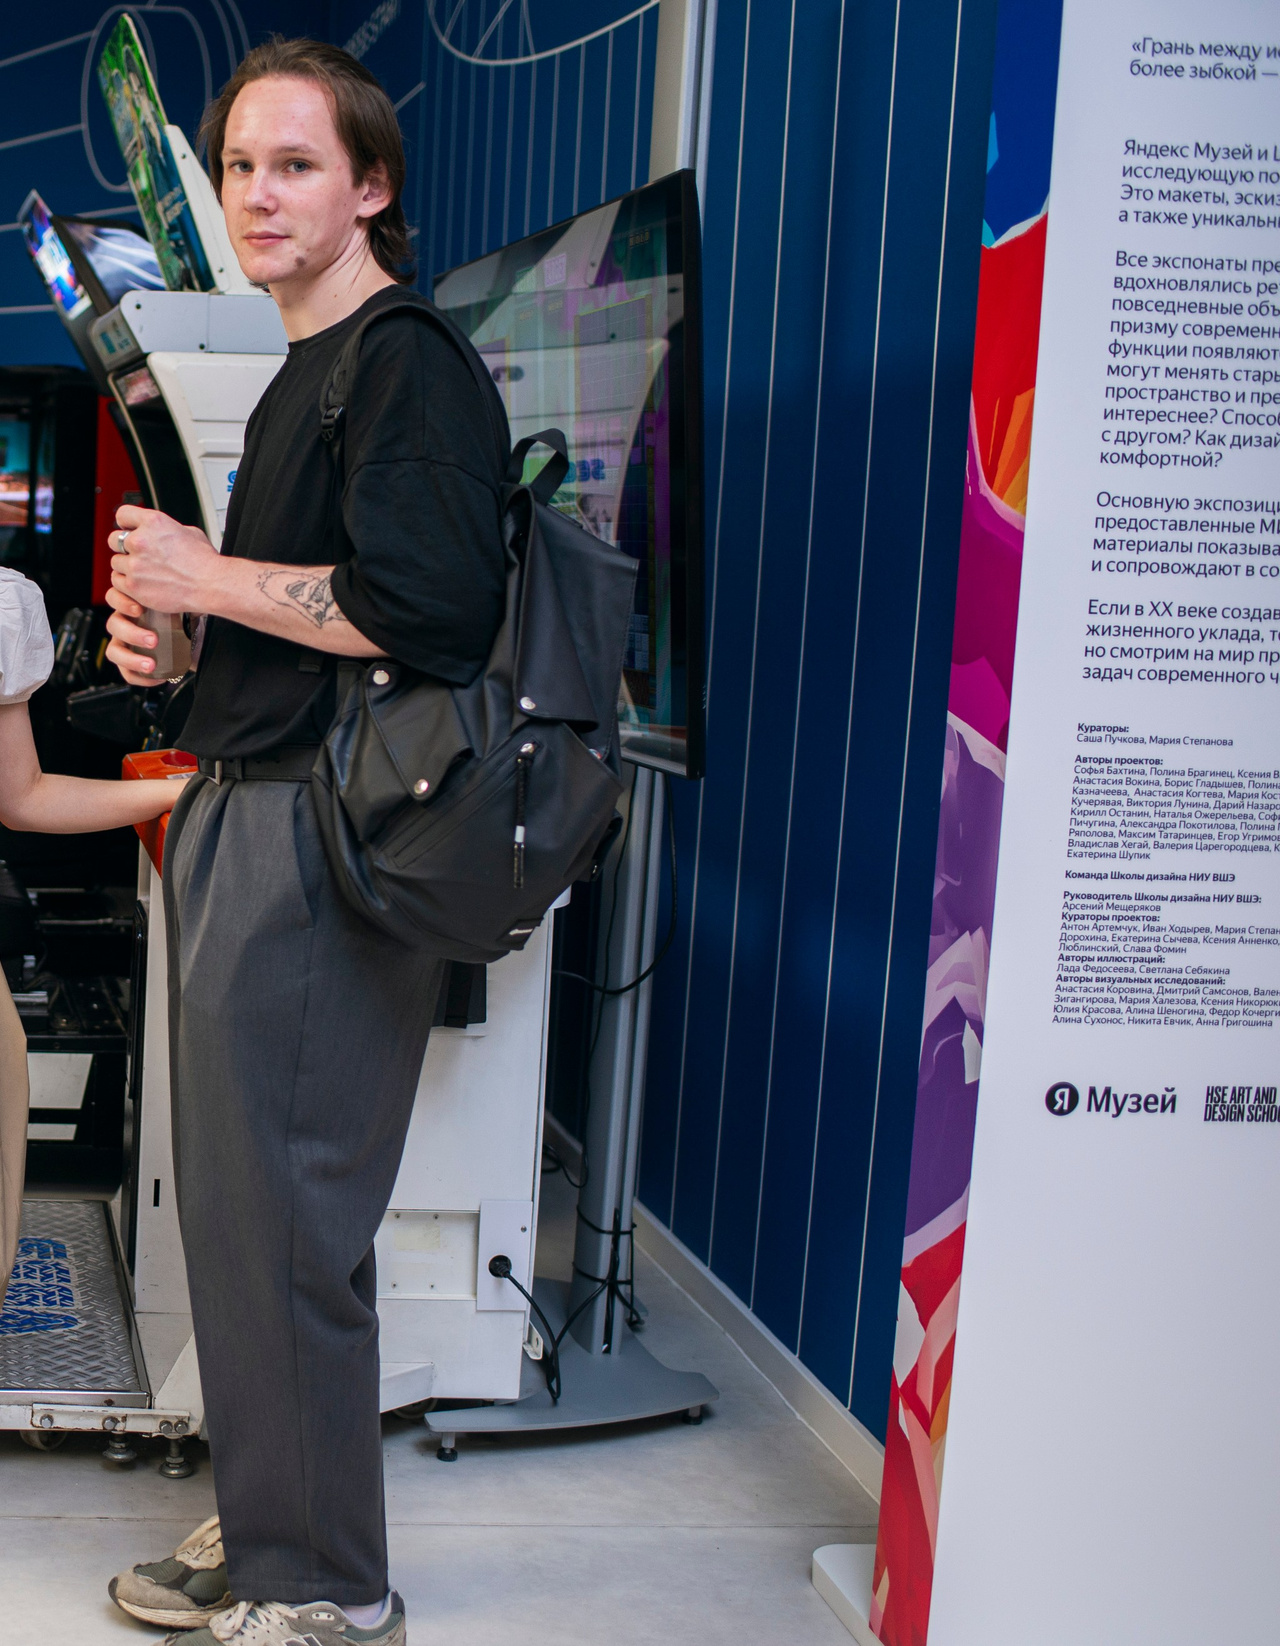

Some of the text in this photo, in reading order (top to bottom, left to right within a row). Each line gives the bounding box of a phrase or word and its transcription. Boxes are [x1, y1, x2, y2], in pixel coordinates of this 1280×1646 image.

[1131, 36, 1195, 58] «Грань
[1198, 43, 1263, 62] между
[1129, 59, 1257, 80] более зыбкой
[1123, 139, 1189, 159] Яндекс
[1193, 142, 1254, 163] Музей
[1256, 148, 1268, 161] и
[1121, 165, 1254, 186] исследующую
[1120, 183, 1229, 206] Это макеты,
[1118, 209, 1188, 224] а также
[1115, 250, 1247, 271] Все экспонаты
[1113, 276, 1252, 293] вдохновлялись
[1111, 298, 1243, 315] повседневные
[1110, 320, 1178, 338] призму
[1108, 338, 1188, 359] функции
[1106, 364, 1228, 382] могут менять
[1104, 385, 1245, 404] пространство и
[1103, 407, 1218, 425] интереснее?
[1101, 428, 1227, 447] с другом? Как
[1099, 448, 1222, 469] комфортной?
[1096, 490, 1189, 513] Основную
[1094, 516, 1255, 533] предоставленные
[1092, 537, 1193, 555] материалы
[1091, 559, 1255, 577] и сопровождают в
[1087, 598, 1130, 615] Если
[1134, 603, 1144, 616] в
[1177, 605, 1217, 618] веке
[1085, 623, 1264, 643] жизненного уклада,
[1084, 645, 1254, 666] но смотрим на мир
[1082, 666, 1265, 685] задач современного
[1077, 722, 1129, 735] Кураторы:
[1076, 733, 1103, 742] Саша
[1148, 734, 1181, 747] Мария
[1182, 735, 1233, 746] Степанова
[1074, 754, 1163, 766] Авторы проектов:
[1073, 764, 1105, 776] Софья
[1149, 766, 1186, 776] Полина
[1237, 768, 1271, 778] Ксения
[1072, 775, 1124, 785] Анастасия
[1164, 777, 1194, 789] Борис
[1133, 787, 1184, 797] Анастасия
[1227, 789, 1259, 801] Мария
[1125, 797, 1172, 809] Виктория
[1212, 799, 1245, 811] Дарий
[1070, 806, 1107, 818] Кирилл
[1153, 808, 1192, 818] Наталья
[1119, 818, 1177, 831] Александра
[1239, 821, 1276, 830] Полина
[1117, 828, 1156, 838] Максим
[1217, 831, 1240, 843] Егор
[1067, 838, 1119, 849] Владислав
[1152, 840, 1193, 852] Валерия
[1066, 848, 1150, 861] Екатерина Шупик
[1064, 869, 1235, 882] Команда Школы дизайна НИУ ВШЭ
[1063, 890, 1261, 903] Руководитель Школы дизайна НИУ ВШЭ:
[1061, 900, 1161, 913] Арсений Мещеряков
[1061, 910, 1160, 923] Кураторы проектов:
[1060, 921, 1090, 931] Антон
[1142, 923, 1167, 932] Иван
[1214, 924, 1246, 936] Мария
[1111, 933, 1161, 945] Екатерина
[1202, 935, 1236, 944] Ксения
[1122, 943, 1186, 953] Слава Фомин
[1057, 952, 1165, 965] Авторы иллюстраций:
[1056, 962, 1081, 974] Лада
[1138, 964, 1183, 974] Светлана
[1055, 973, 1225, 986] Авторы визуальных исследований:
[1055, 983, 1104, 993] Анастасия
[1156, 985, 1200, 997] Дмитрий
[1118, 994, 1234, 1006] Мария Ксения
[1053, 1003, 1080, 1013] Юлия
[1124, 1005, 1155, 1014] Алина
[1208, 1006, 1241, 1018] Федор
[1052, 1014, 1082, 1023] Алина
[1127, 1015, 1162, 1025] Никита
[1195, 1016, 1219, 1026] Анна
[1087, 1086, 1177, 1118] Музей
[1205, 1086, 1277, 1104] HSE ART AND
[1204, 1104, 1245, 1122] DESIGN
